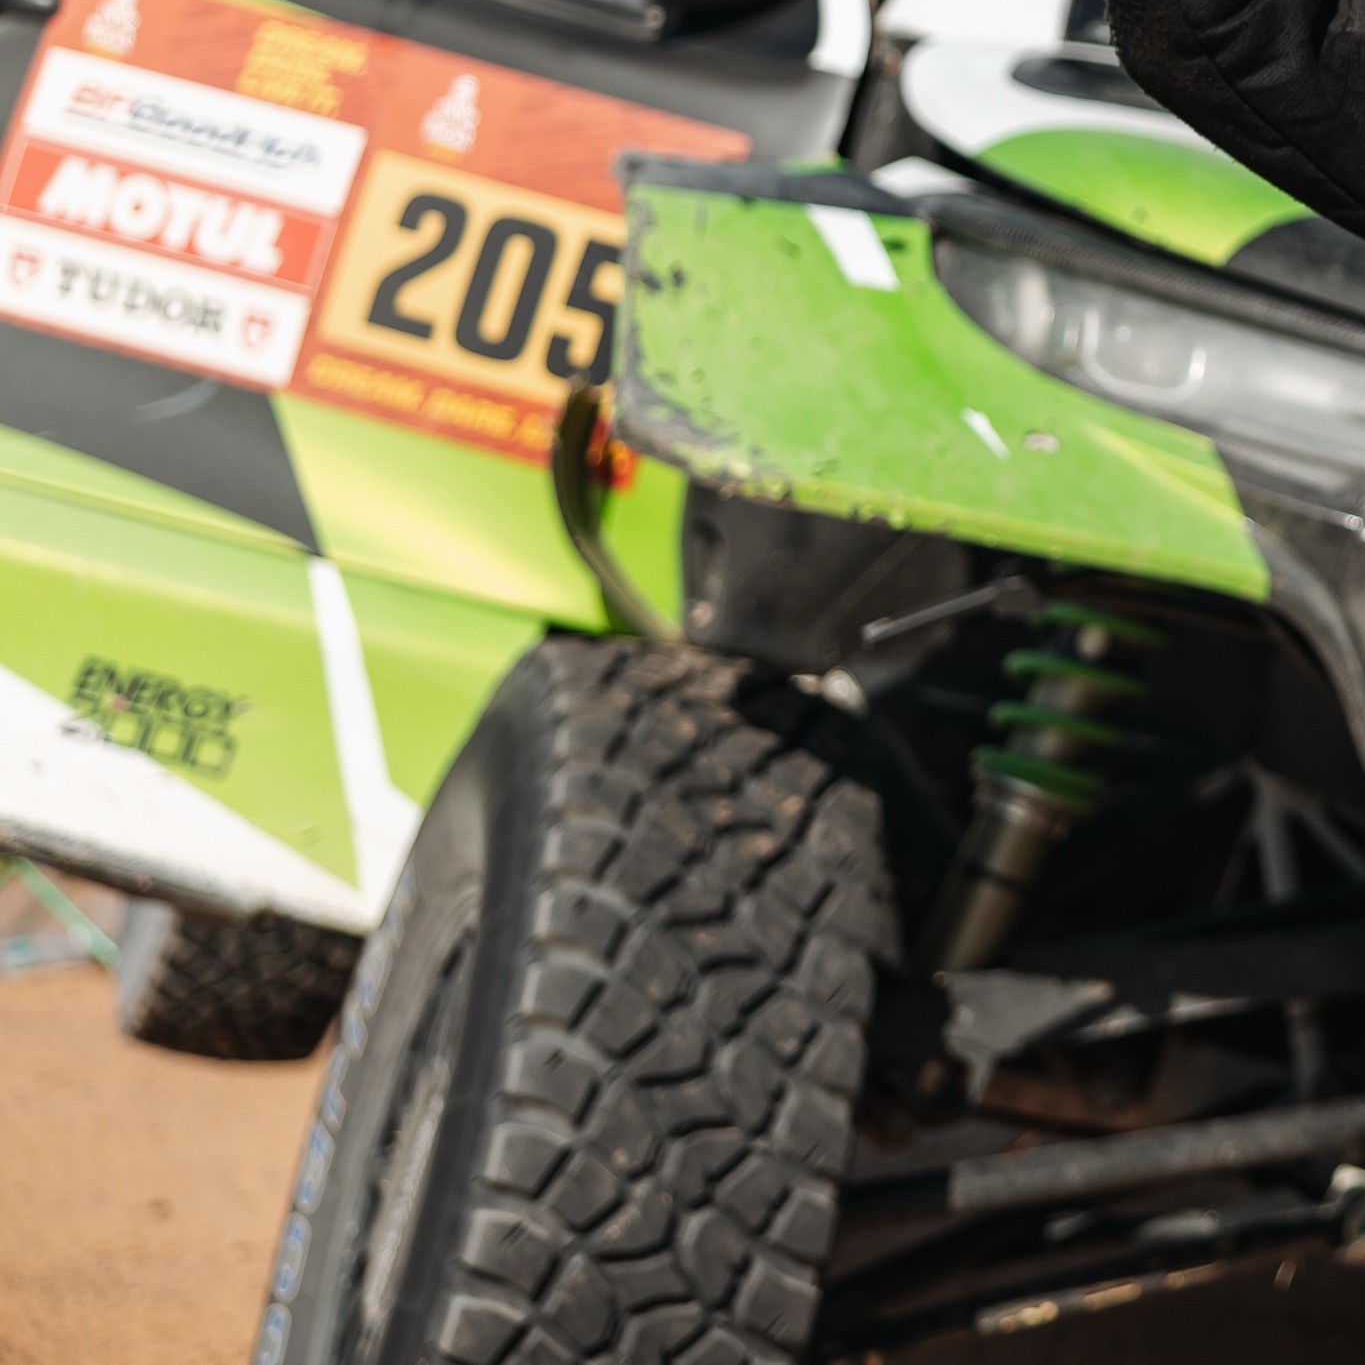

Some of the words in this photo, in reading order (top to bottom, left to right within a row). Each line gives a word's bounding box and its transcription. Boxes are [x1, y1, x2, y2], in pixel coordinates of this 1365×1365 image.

[40, 154, 284, 276] MOTUL
[57, 256, 227, 333] TUDOR
[367, 194, 622, 386] 205
[72, 653, 250, 729] ENERGY
